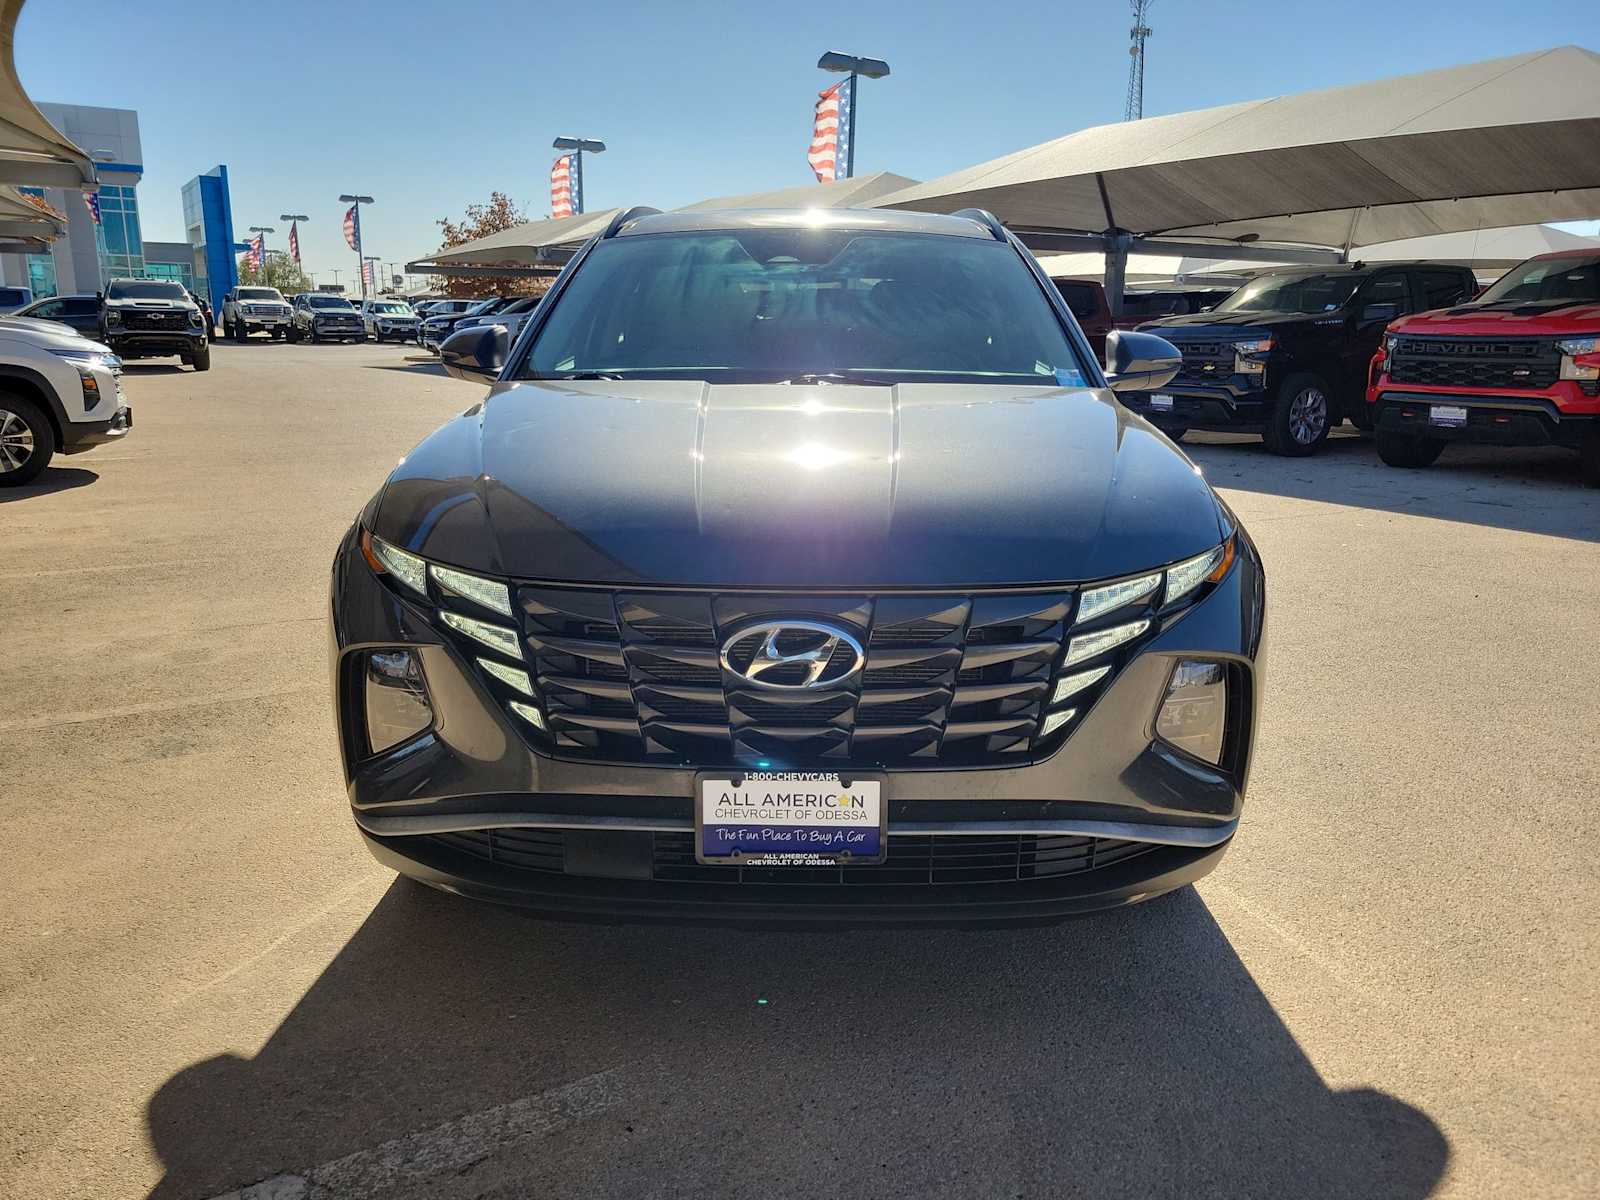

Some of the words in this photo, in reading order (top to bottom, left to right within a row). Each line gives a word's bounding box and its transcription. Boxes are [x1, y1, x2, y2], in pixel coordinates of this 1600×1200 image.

[744, 772, 839, 781] 1-800-CHEVYCARS
[718, 792, 755, 806] ALL
[762, 793, 864, 808] AMERICN
[715, 808, 792, 819] CHEVROLET
[794, 809, 812, 819] OF
[815, 810, 868, 820] ODESSA
[715, 828, 736, 841] The
[738, 829, 759, 841] Fun
[761, 828, 791, 841] Place
[793, 829, 807, 841] To
[809, 830, 832, 845] Buy
[833, 830, 844, 842] A
[846, 830, 866, 842] Car
